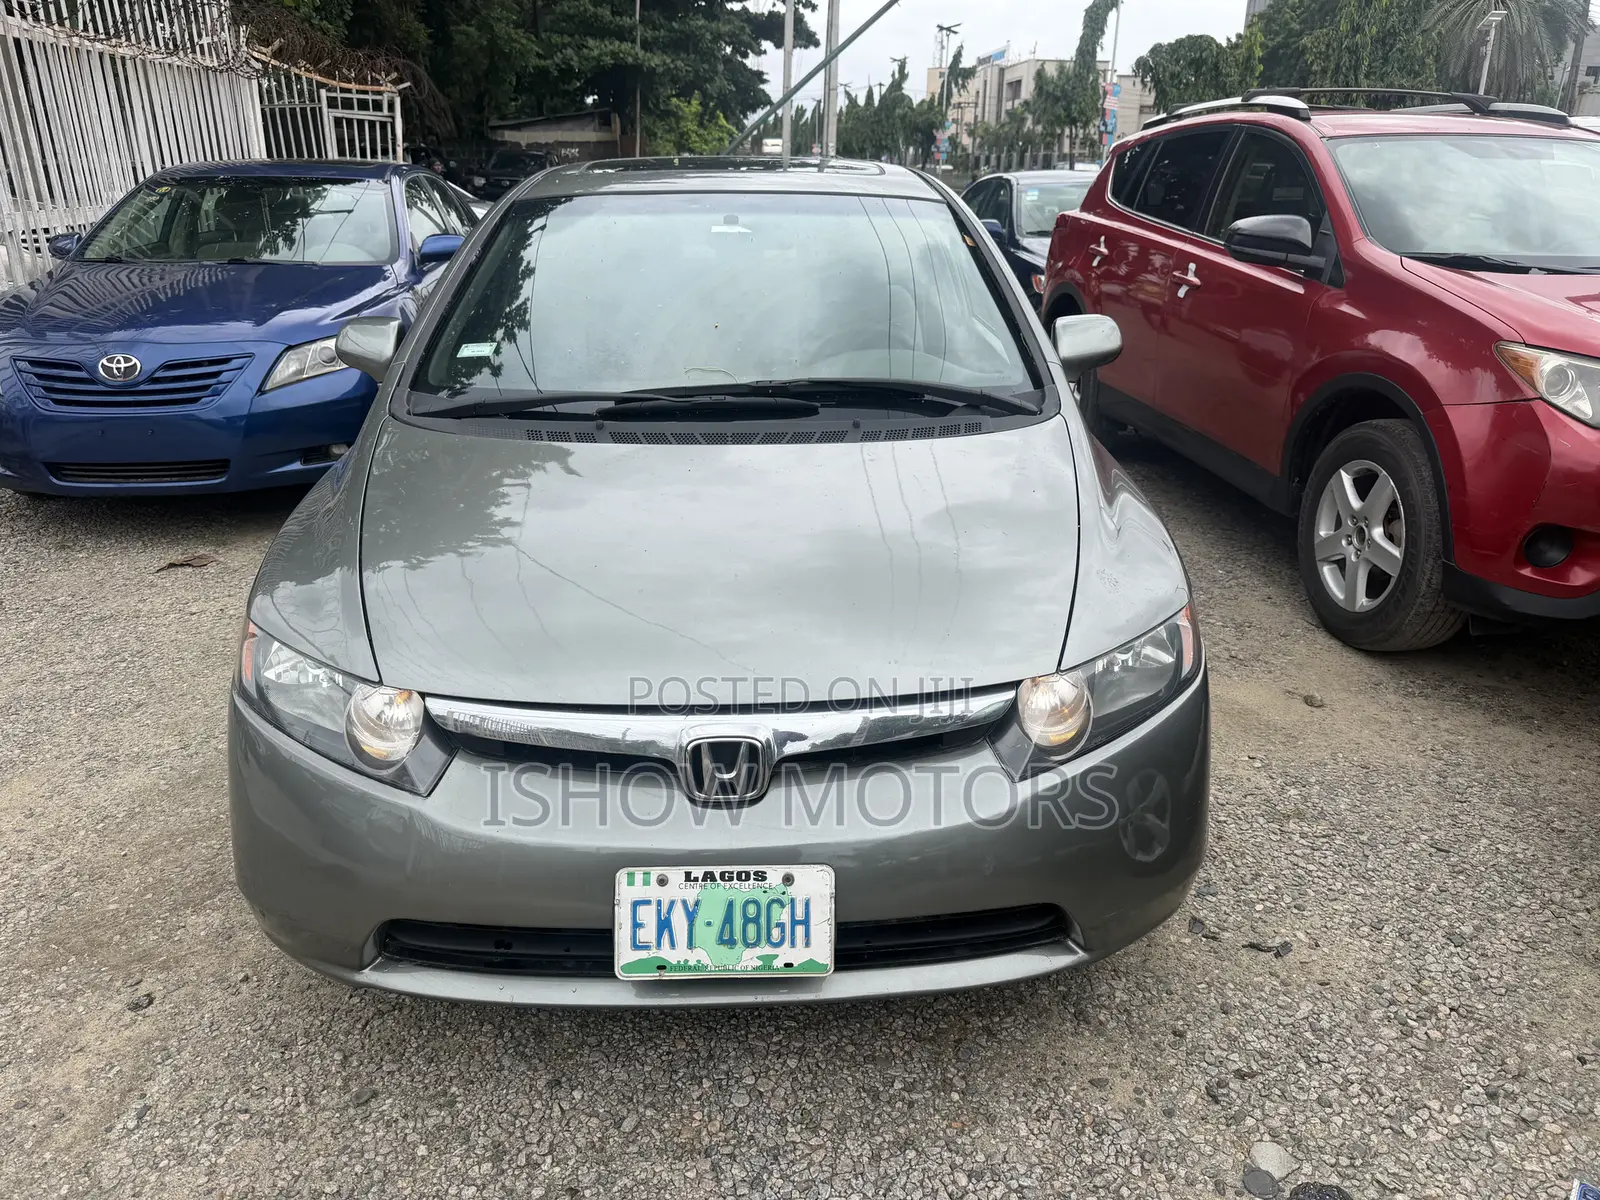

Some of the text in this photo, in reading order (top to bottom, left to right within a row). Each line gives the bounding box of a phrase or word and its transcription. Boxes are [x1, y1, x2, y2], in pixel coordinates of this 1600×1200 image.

[683, 870, 768, 883] LAGOS
[678, 882, 774, 890] CENTRE OF EXCELLENCE
[740, 964, 750, 972] OF
[751, 964, 780, 972] NIGERIA
